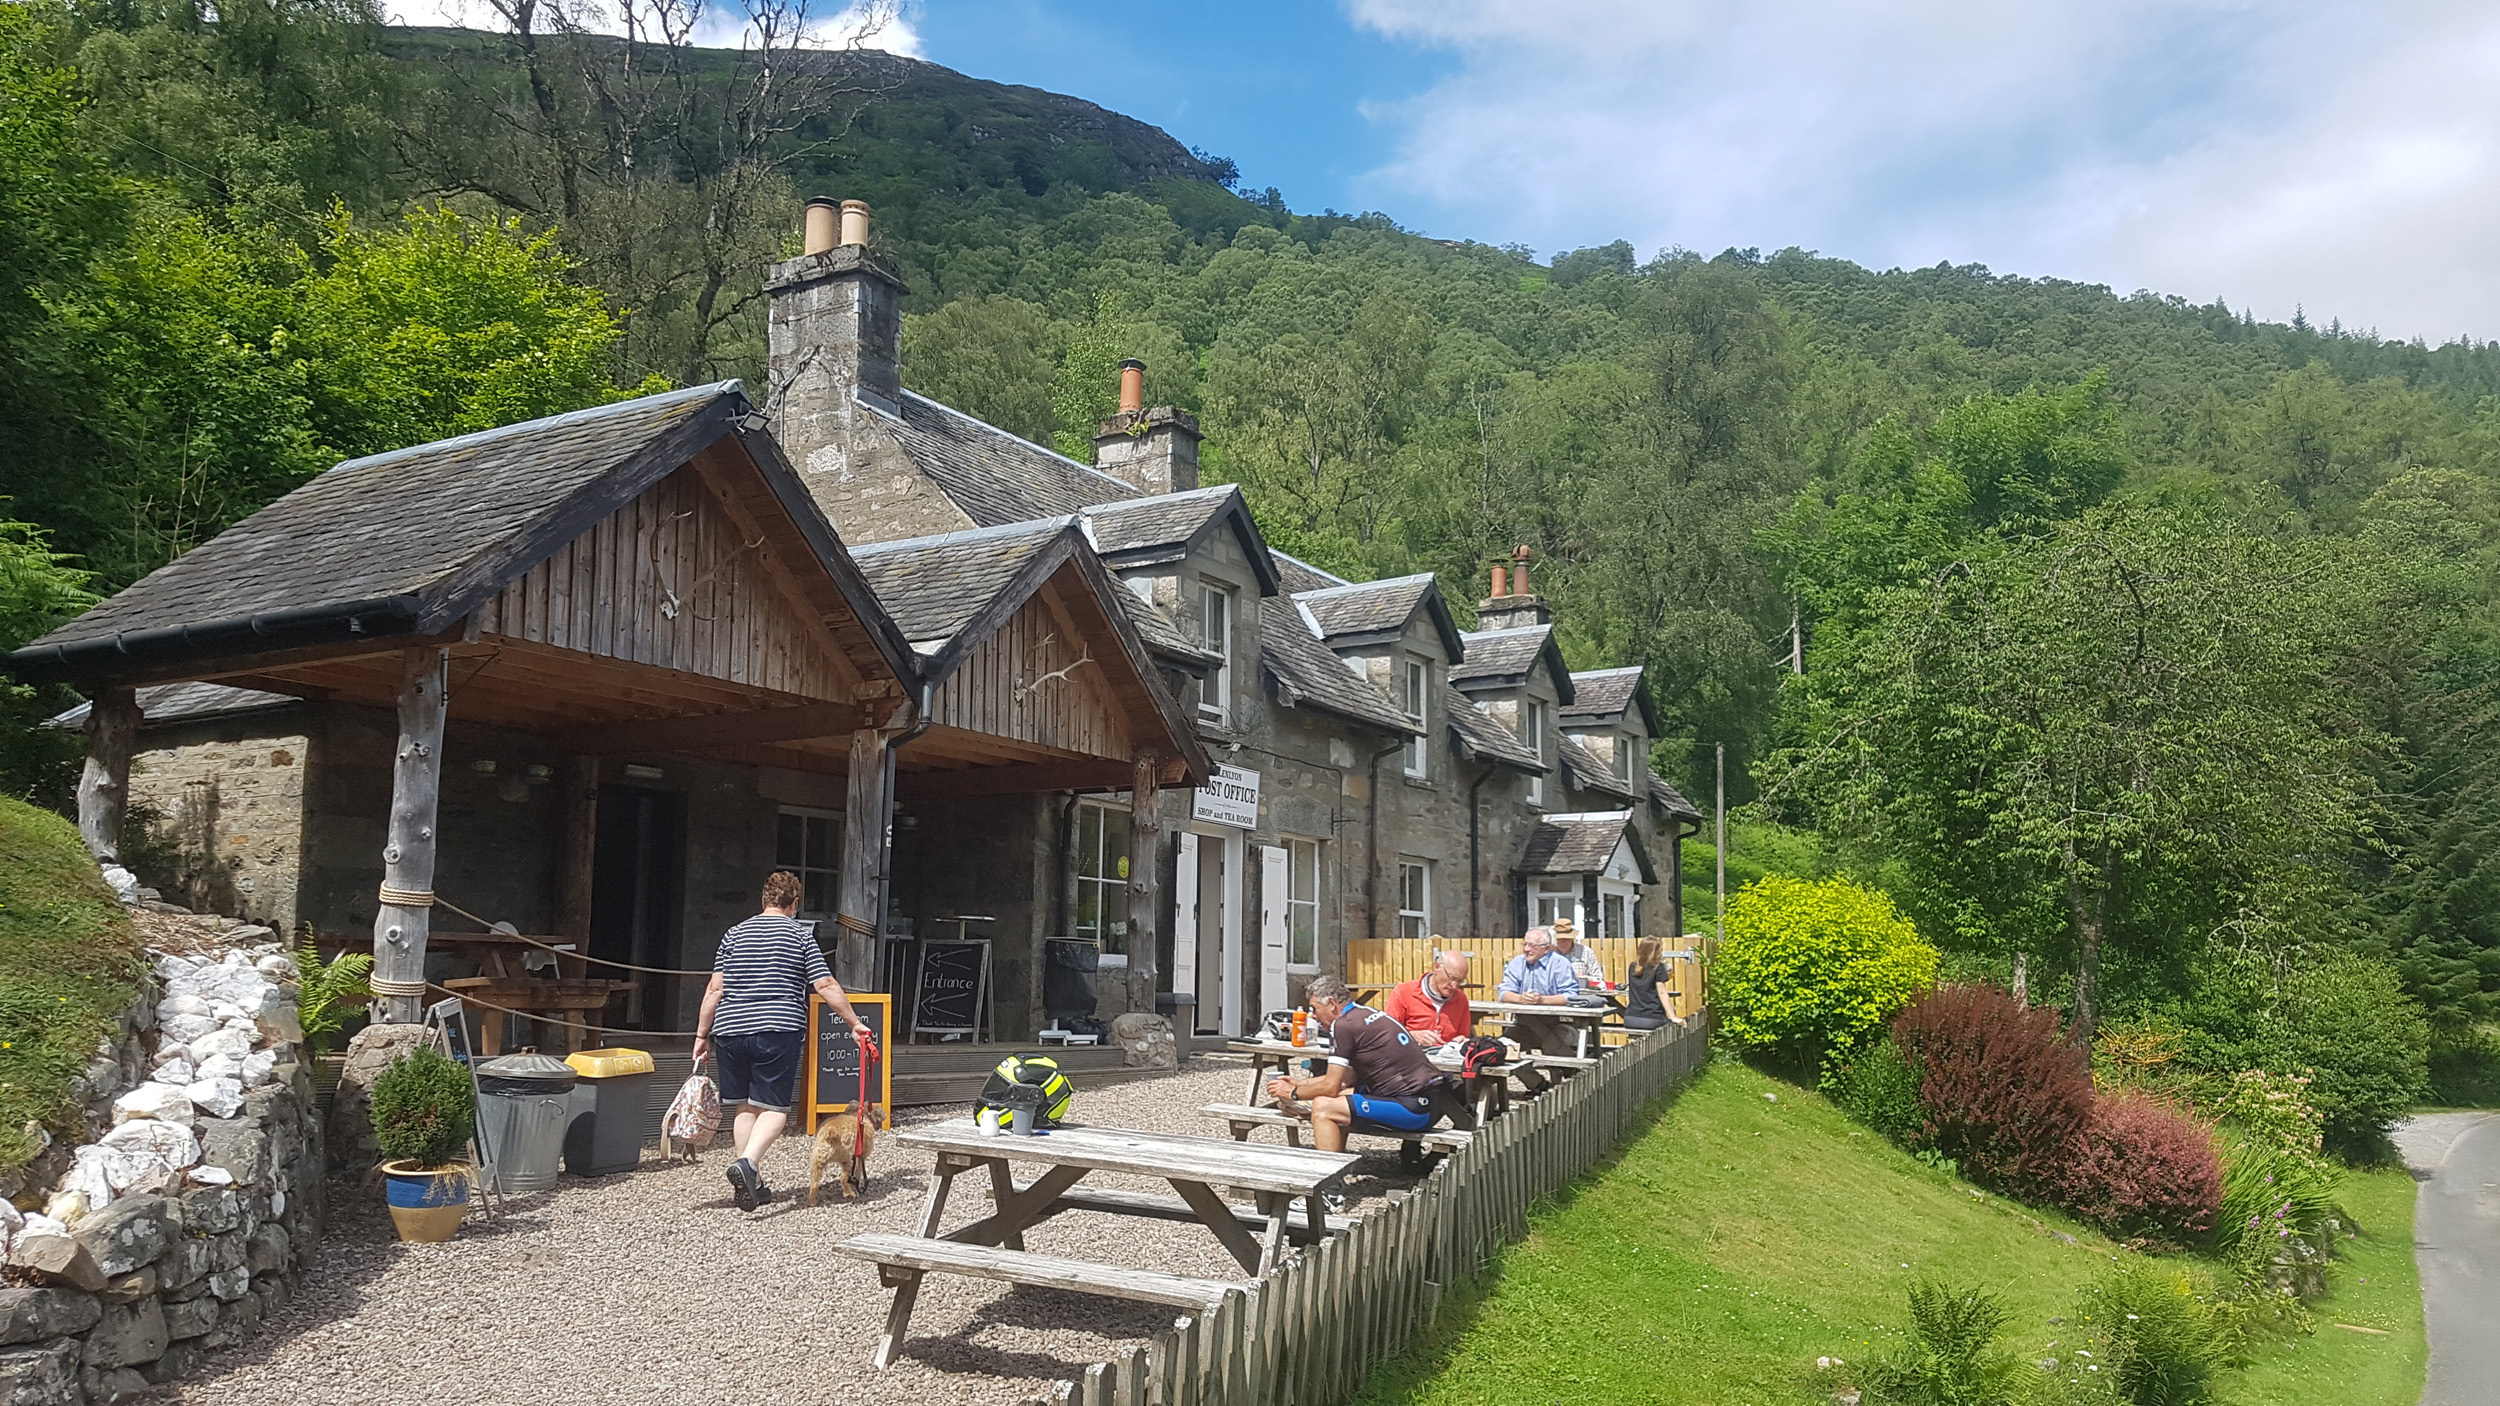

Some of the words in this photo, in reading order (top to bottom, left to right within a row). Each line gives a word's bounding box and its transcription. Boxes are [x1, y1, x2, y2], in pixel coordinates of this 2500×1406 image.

[1224, 783, 1256, 804] OFFICE
[1197, 806, 1213, 818] SHOP
[1213, 811, 1224, 819] and
[1225, 812, 1235, 822] TEA
[1236, 815, 1254, 825] ROOM
[924, 971, 974, 989] Entrance
[821, 1031, 841, 1045] open
